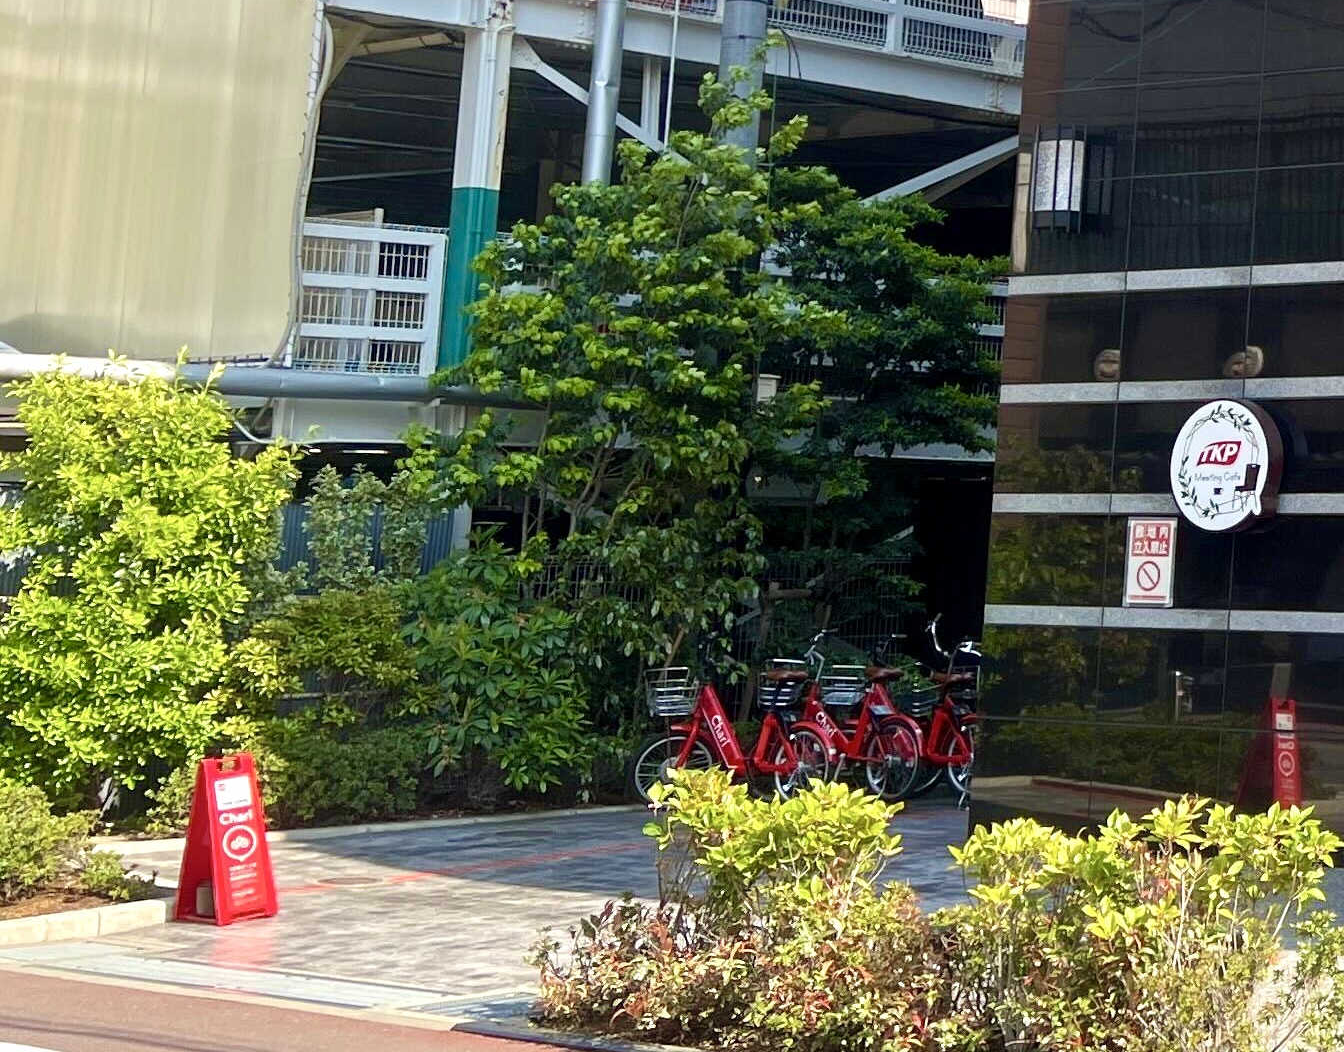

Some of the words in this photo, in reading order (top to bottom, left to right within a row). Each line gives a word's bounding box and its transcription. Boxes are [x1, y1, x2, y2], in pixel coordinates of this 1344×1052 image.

[1199, 442, 1239, 463] TKP
[1194, 472, 1222, 484] Meeting
[1133, 540, 1168, 555] 立入禁止
